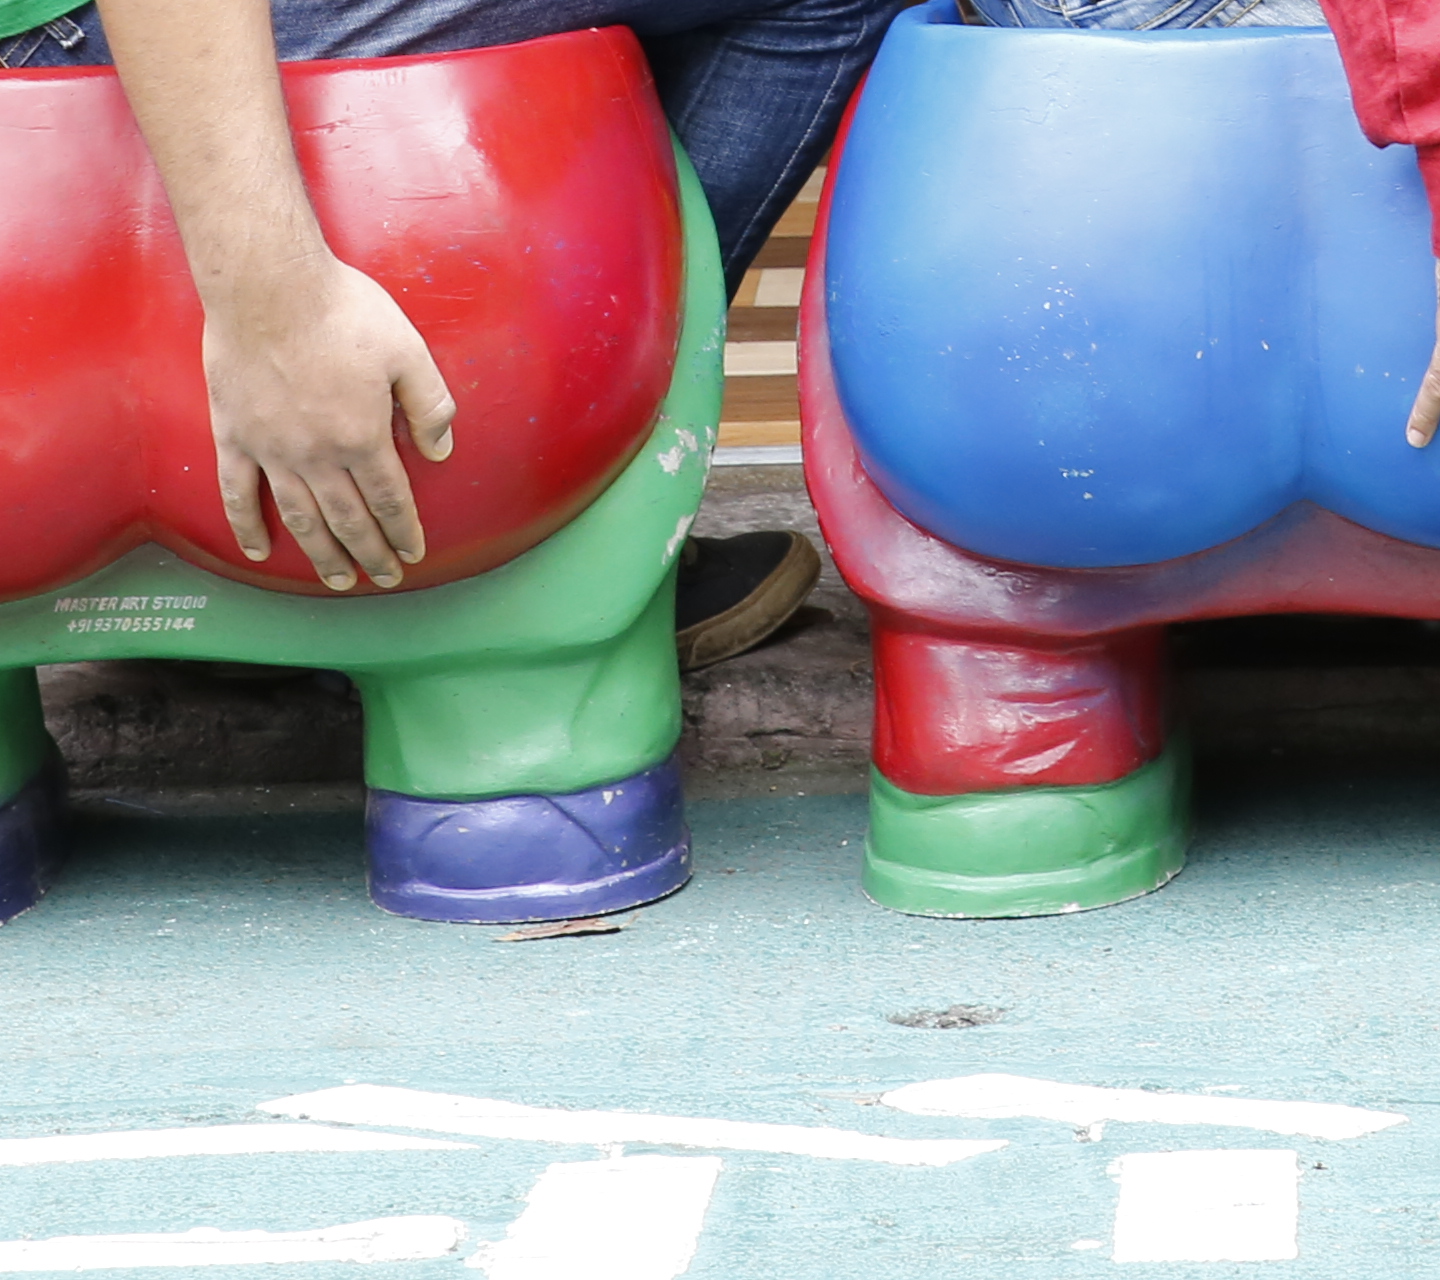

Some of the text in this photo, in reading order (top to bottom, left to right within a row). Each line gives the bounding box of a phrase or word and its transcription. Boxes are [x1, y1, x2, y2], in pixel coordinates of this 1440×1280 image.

[54, 595, 208, 613] MASTER ART STUDIO
